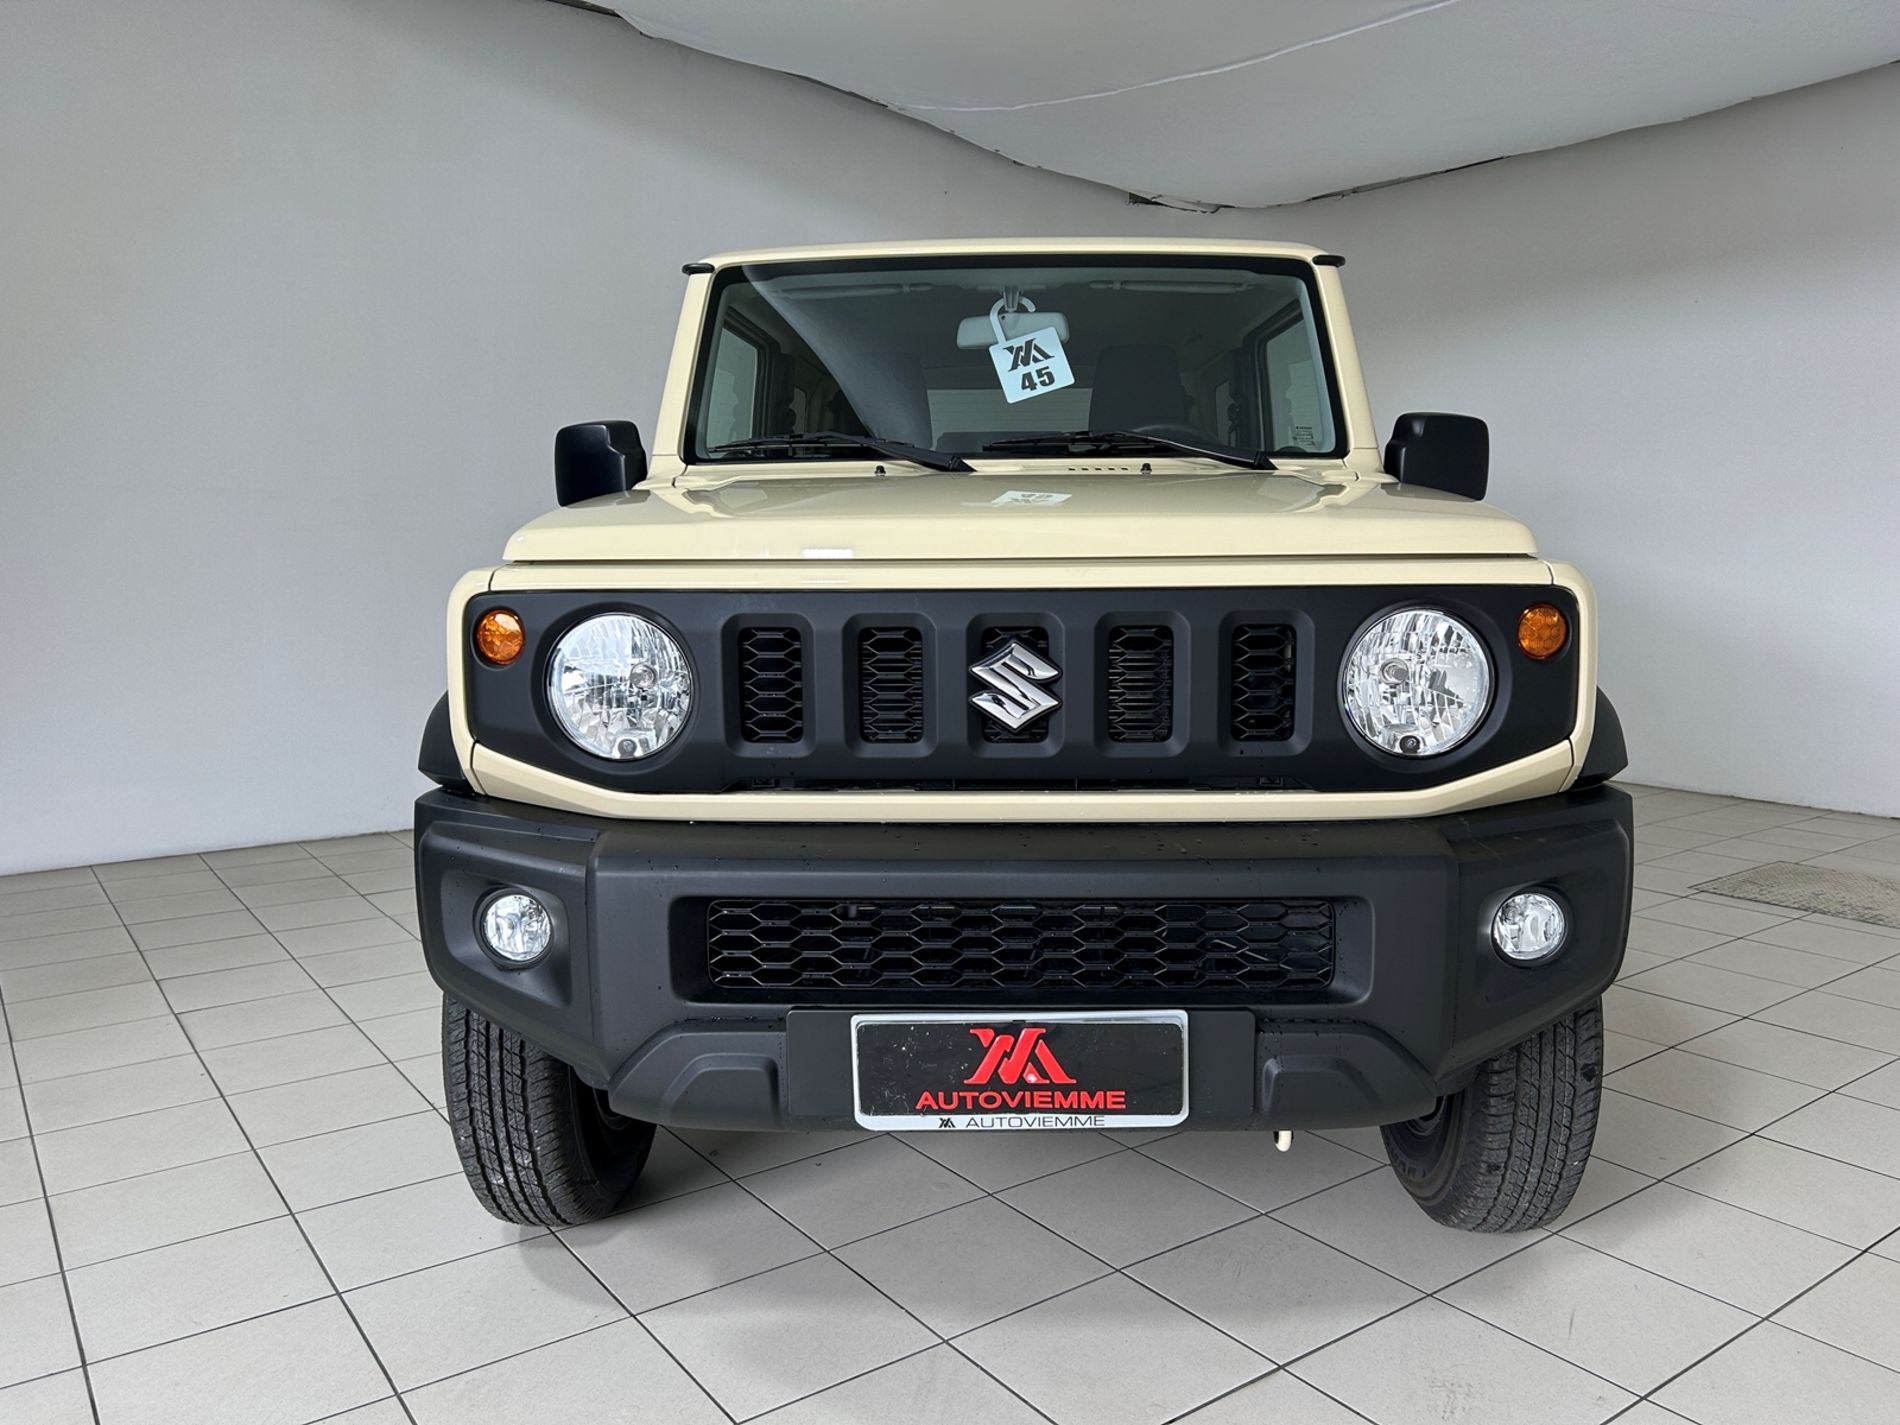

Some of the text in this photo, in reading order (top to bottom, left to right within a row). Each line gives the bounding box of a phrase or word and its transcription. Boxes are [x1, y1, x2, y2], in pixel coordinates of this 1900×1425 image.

[1020, 365, 1056, 392] 45
[915, 1091, 1127, 1110] AUTOVIEMME
[965, 1115, 1106, 1128] AUTOVIEMME
